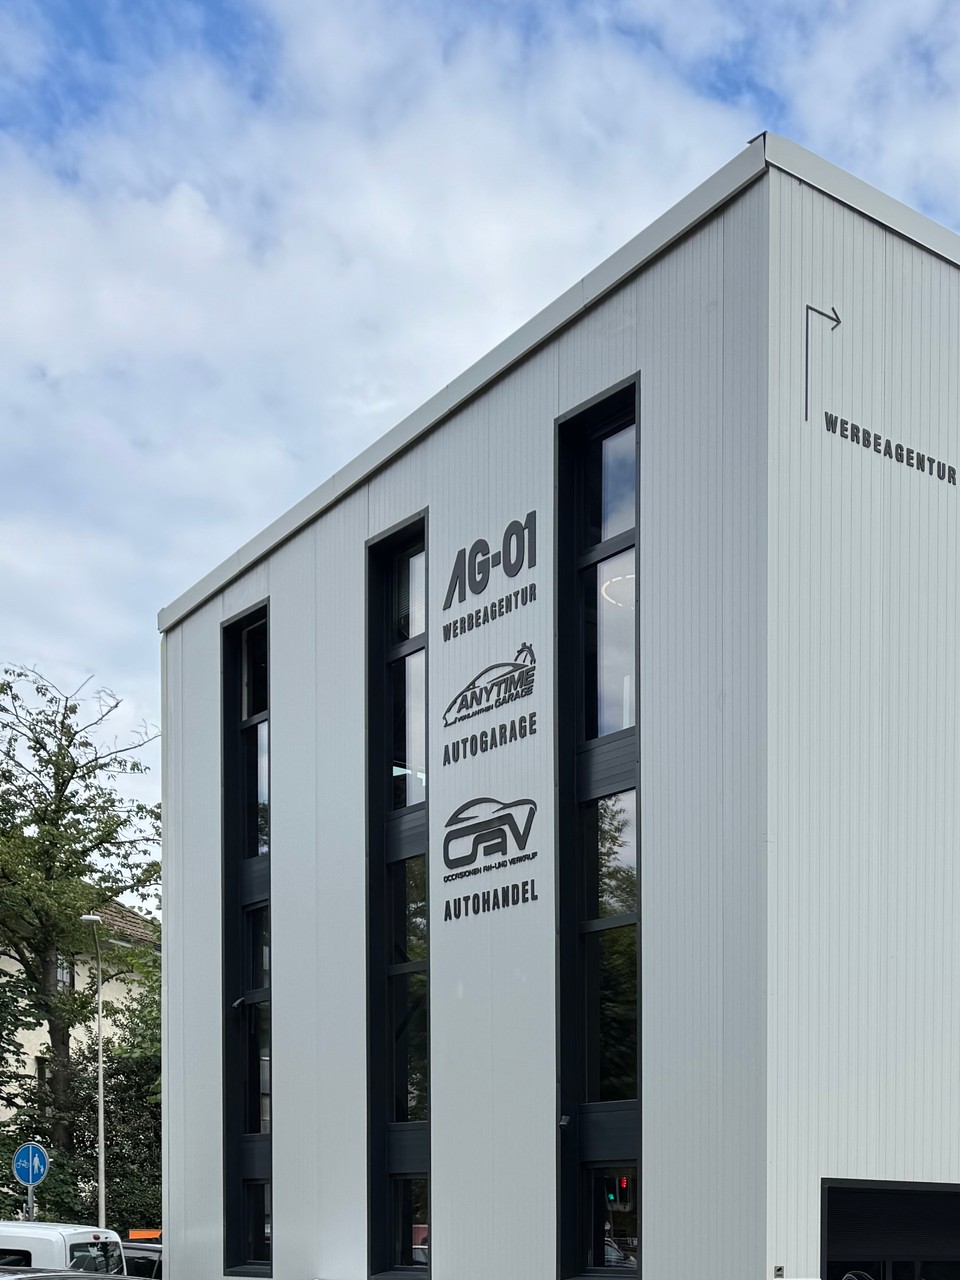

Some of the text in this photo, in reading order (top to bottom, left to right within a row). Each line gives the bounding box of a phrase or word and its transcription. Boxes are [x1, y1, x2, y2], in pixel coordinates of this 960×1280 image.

[824, 411, 957, 486] WERBEAGENTUR
[443, 510, 537, 611] AG-01
[443, 582, 537, 642] WERBEAGENTUR
[456, 665, 536, 714] ANYTIME
[495, 685, 534, 709] GARAGE
[443, 712, 537, 766] AUTOGARAGE
[443, 879, 538, 922] AUTOHANDEL
